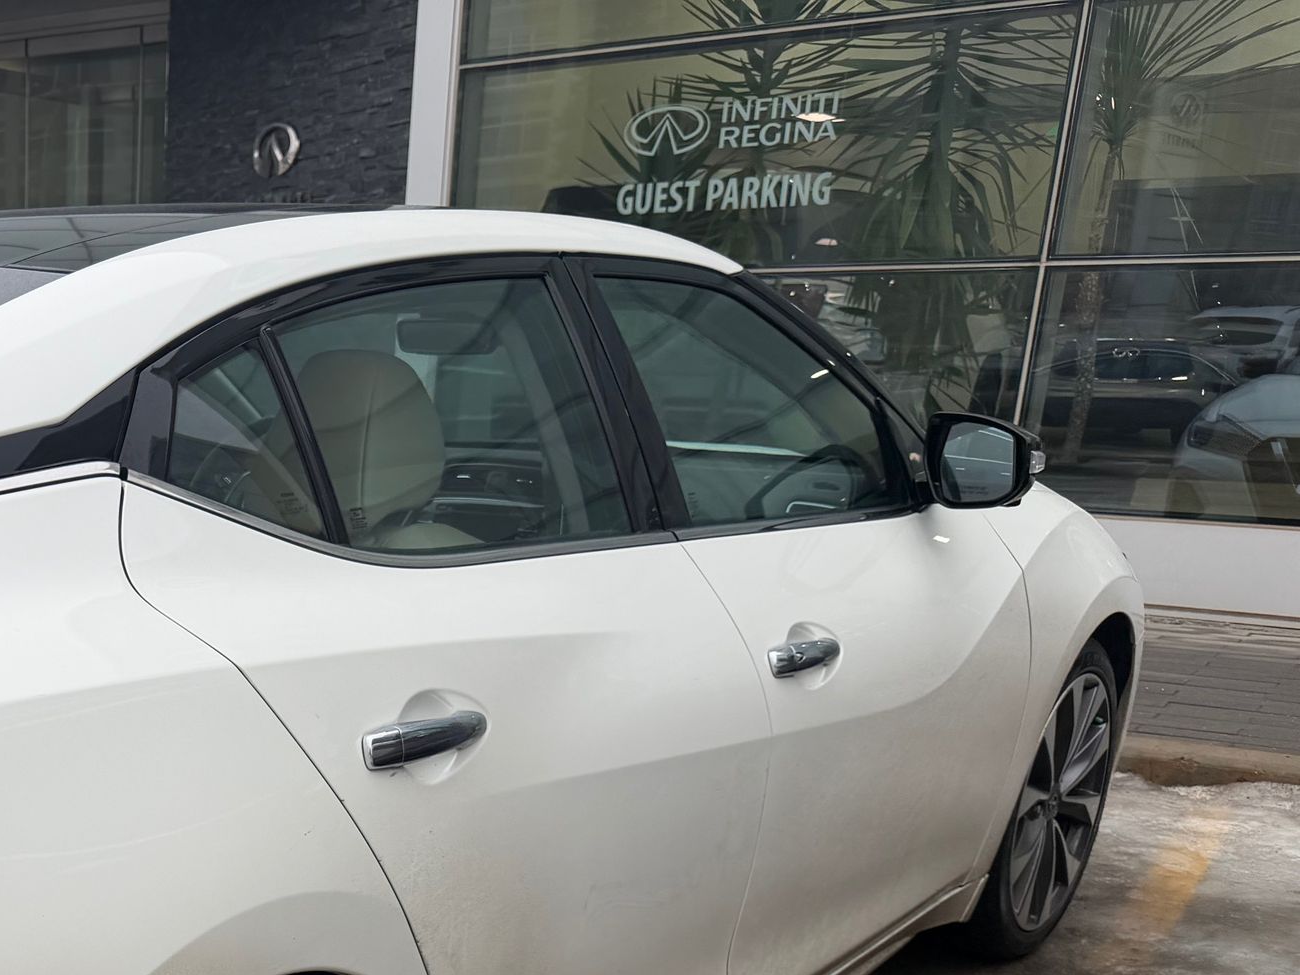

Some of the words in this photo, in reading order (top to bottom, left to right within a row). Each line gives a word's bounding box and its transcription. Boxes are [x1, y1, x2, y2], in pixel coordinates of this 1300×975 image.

[721, 92, 840, 123] INFINITI
[719, 121, 837, 150] REGINA
[617, 180, 700, 216] GUEST
[705, 172, 834, 212] PARKING
